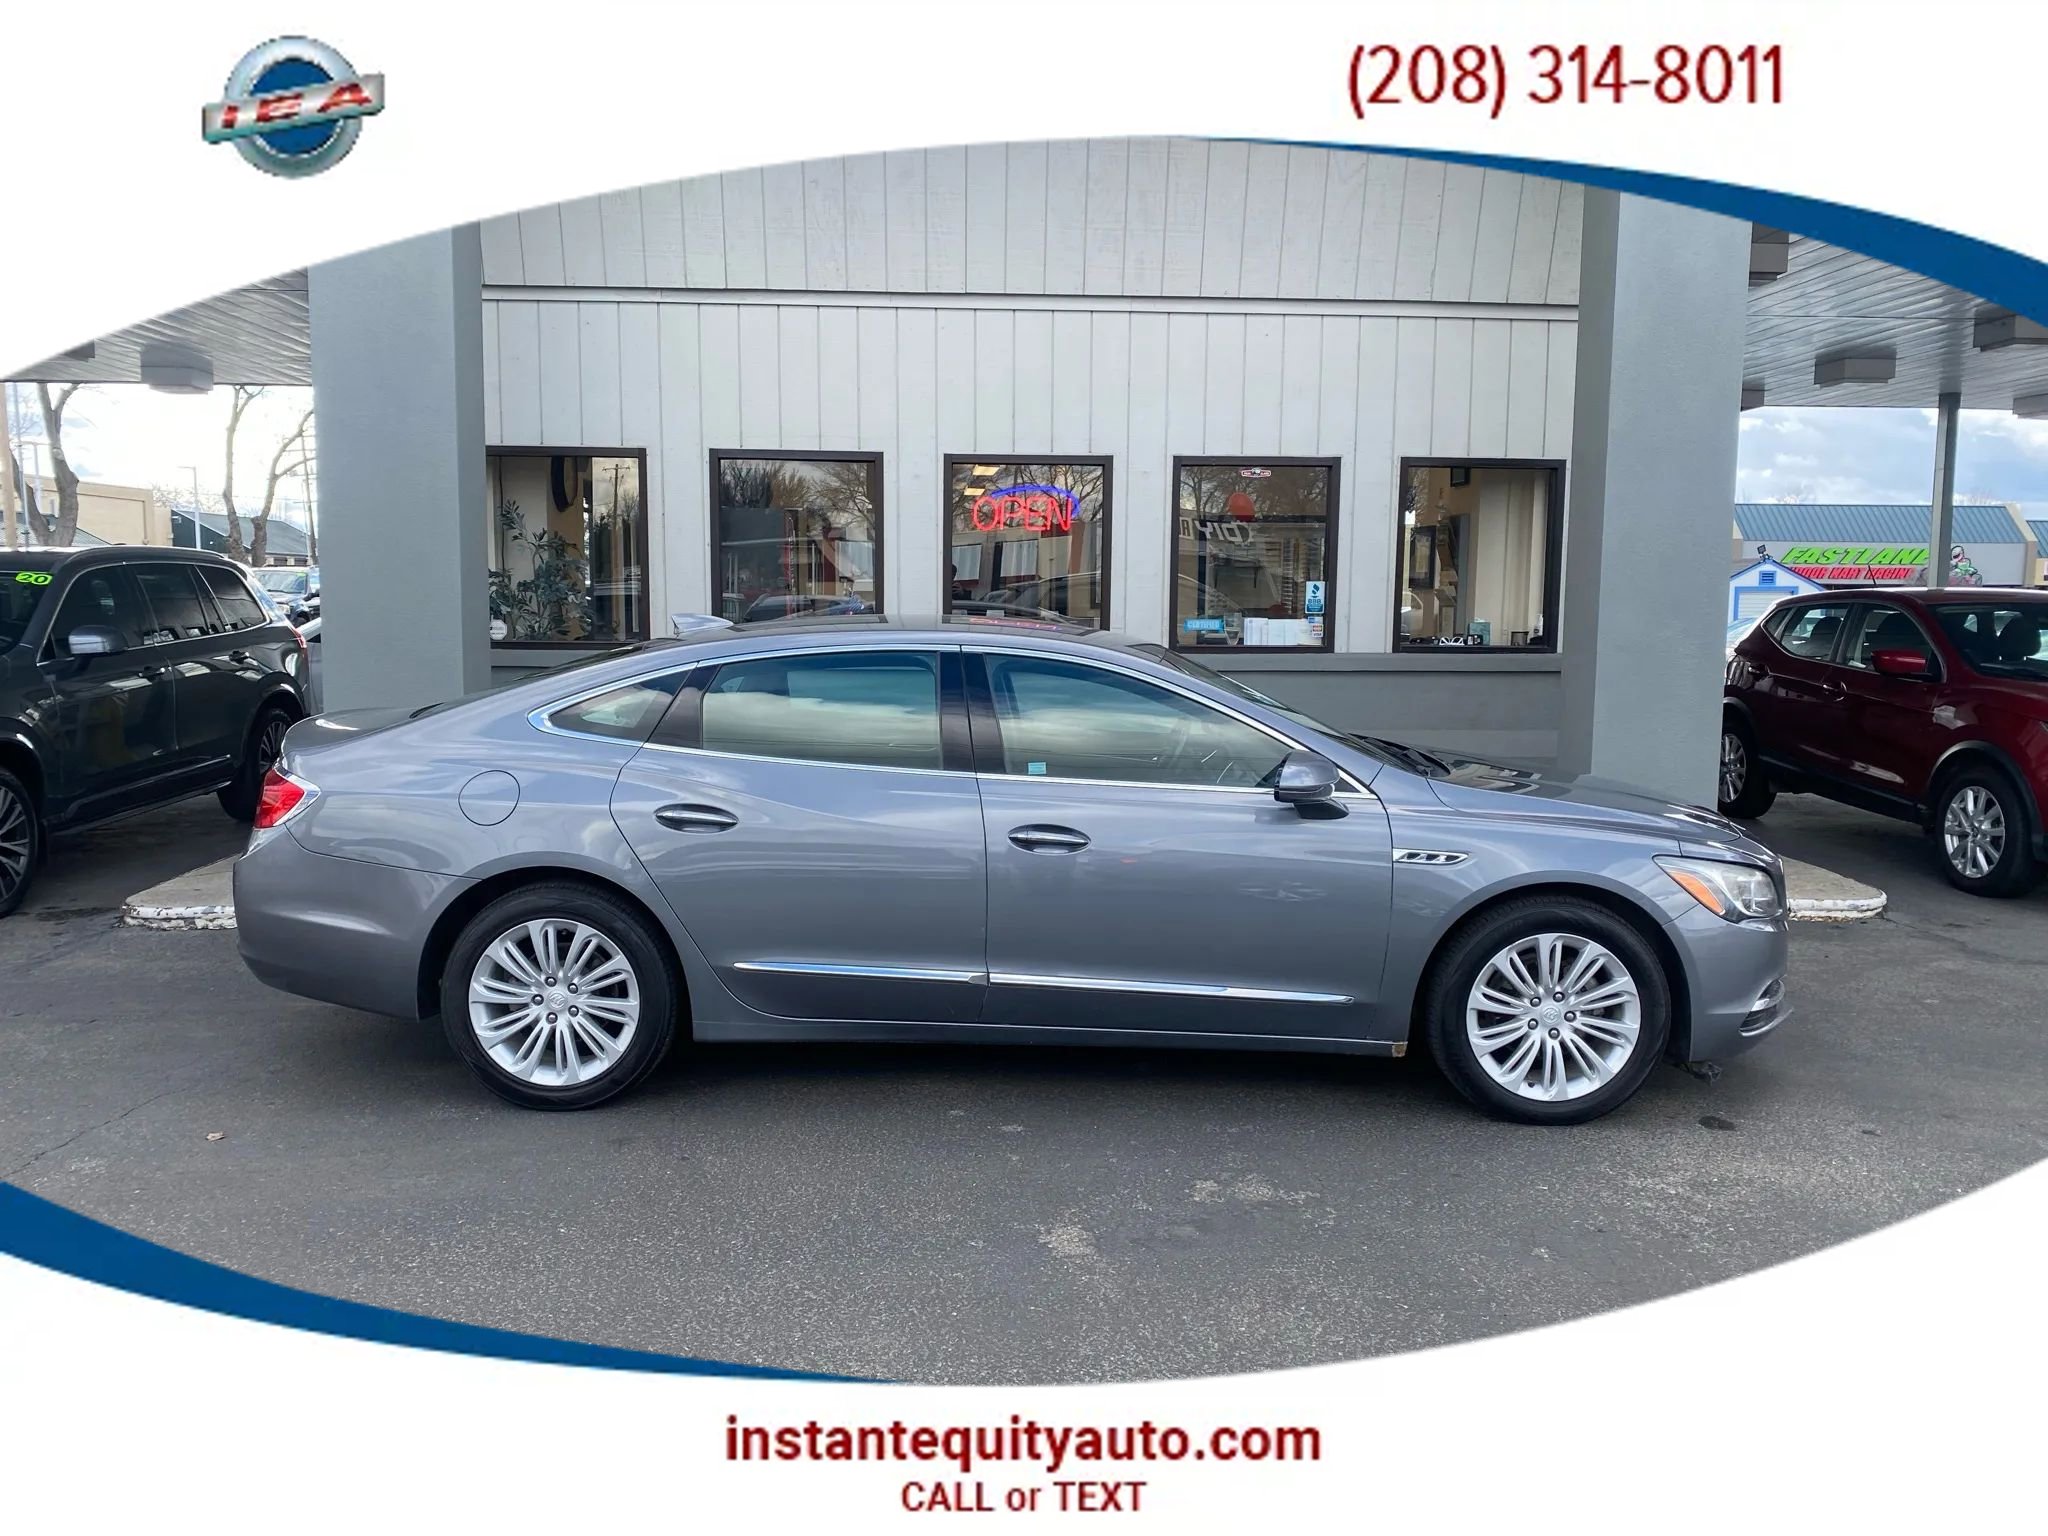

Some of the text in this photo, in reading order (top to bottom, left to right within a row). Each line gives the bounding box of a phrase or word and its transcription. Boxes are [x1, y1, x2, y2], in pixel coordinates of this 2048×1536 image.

[971, 494, 1074, 533] OPEN
[1781, 547, 1930, 565] FASTLANE
[17, 573, 51, 584] 20
